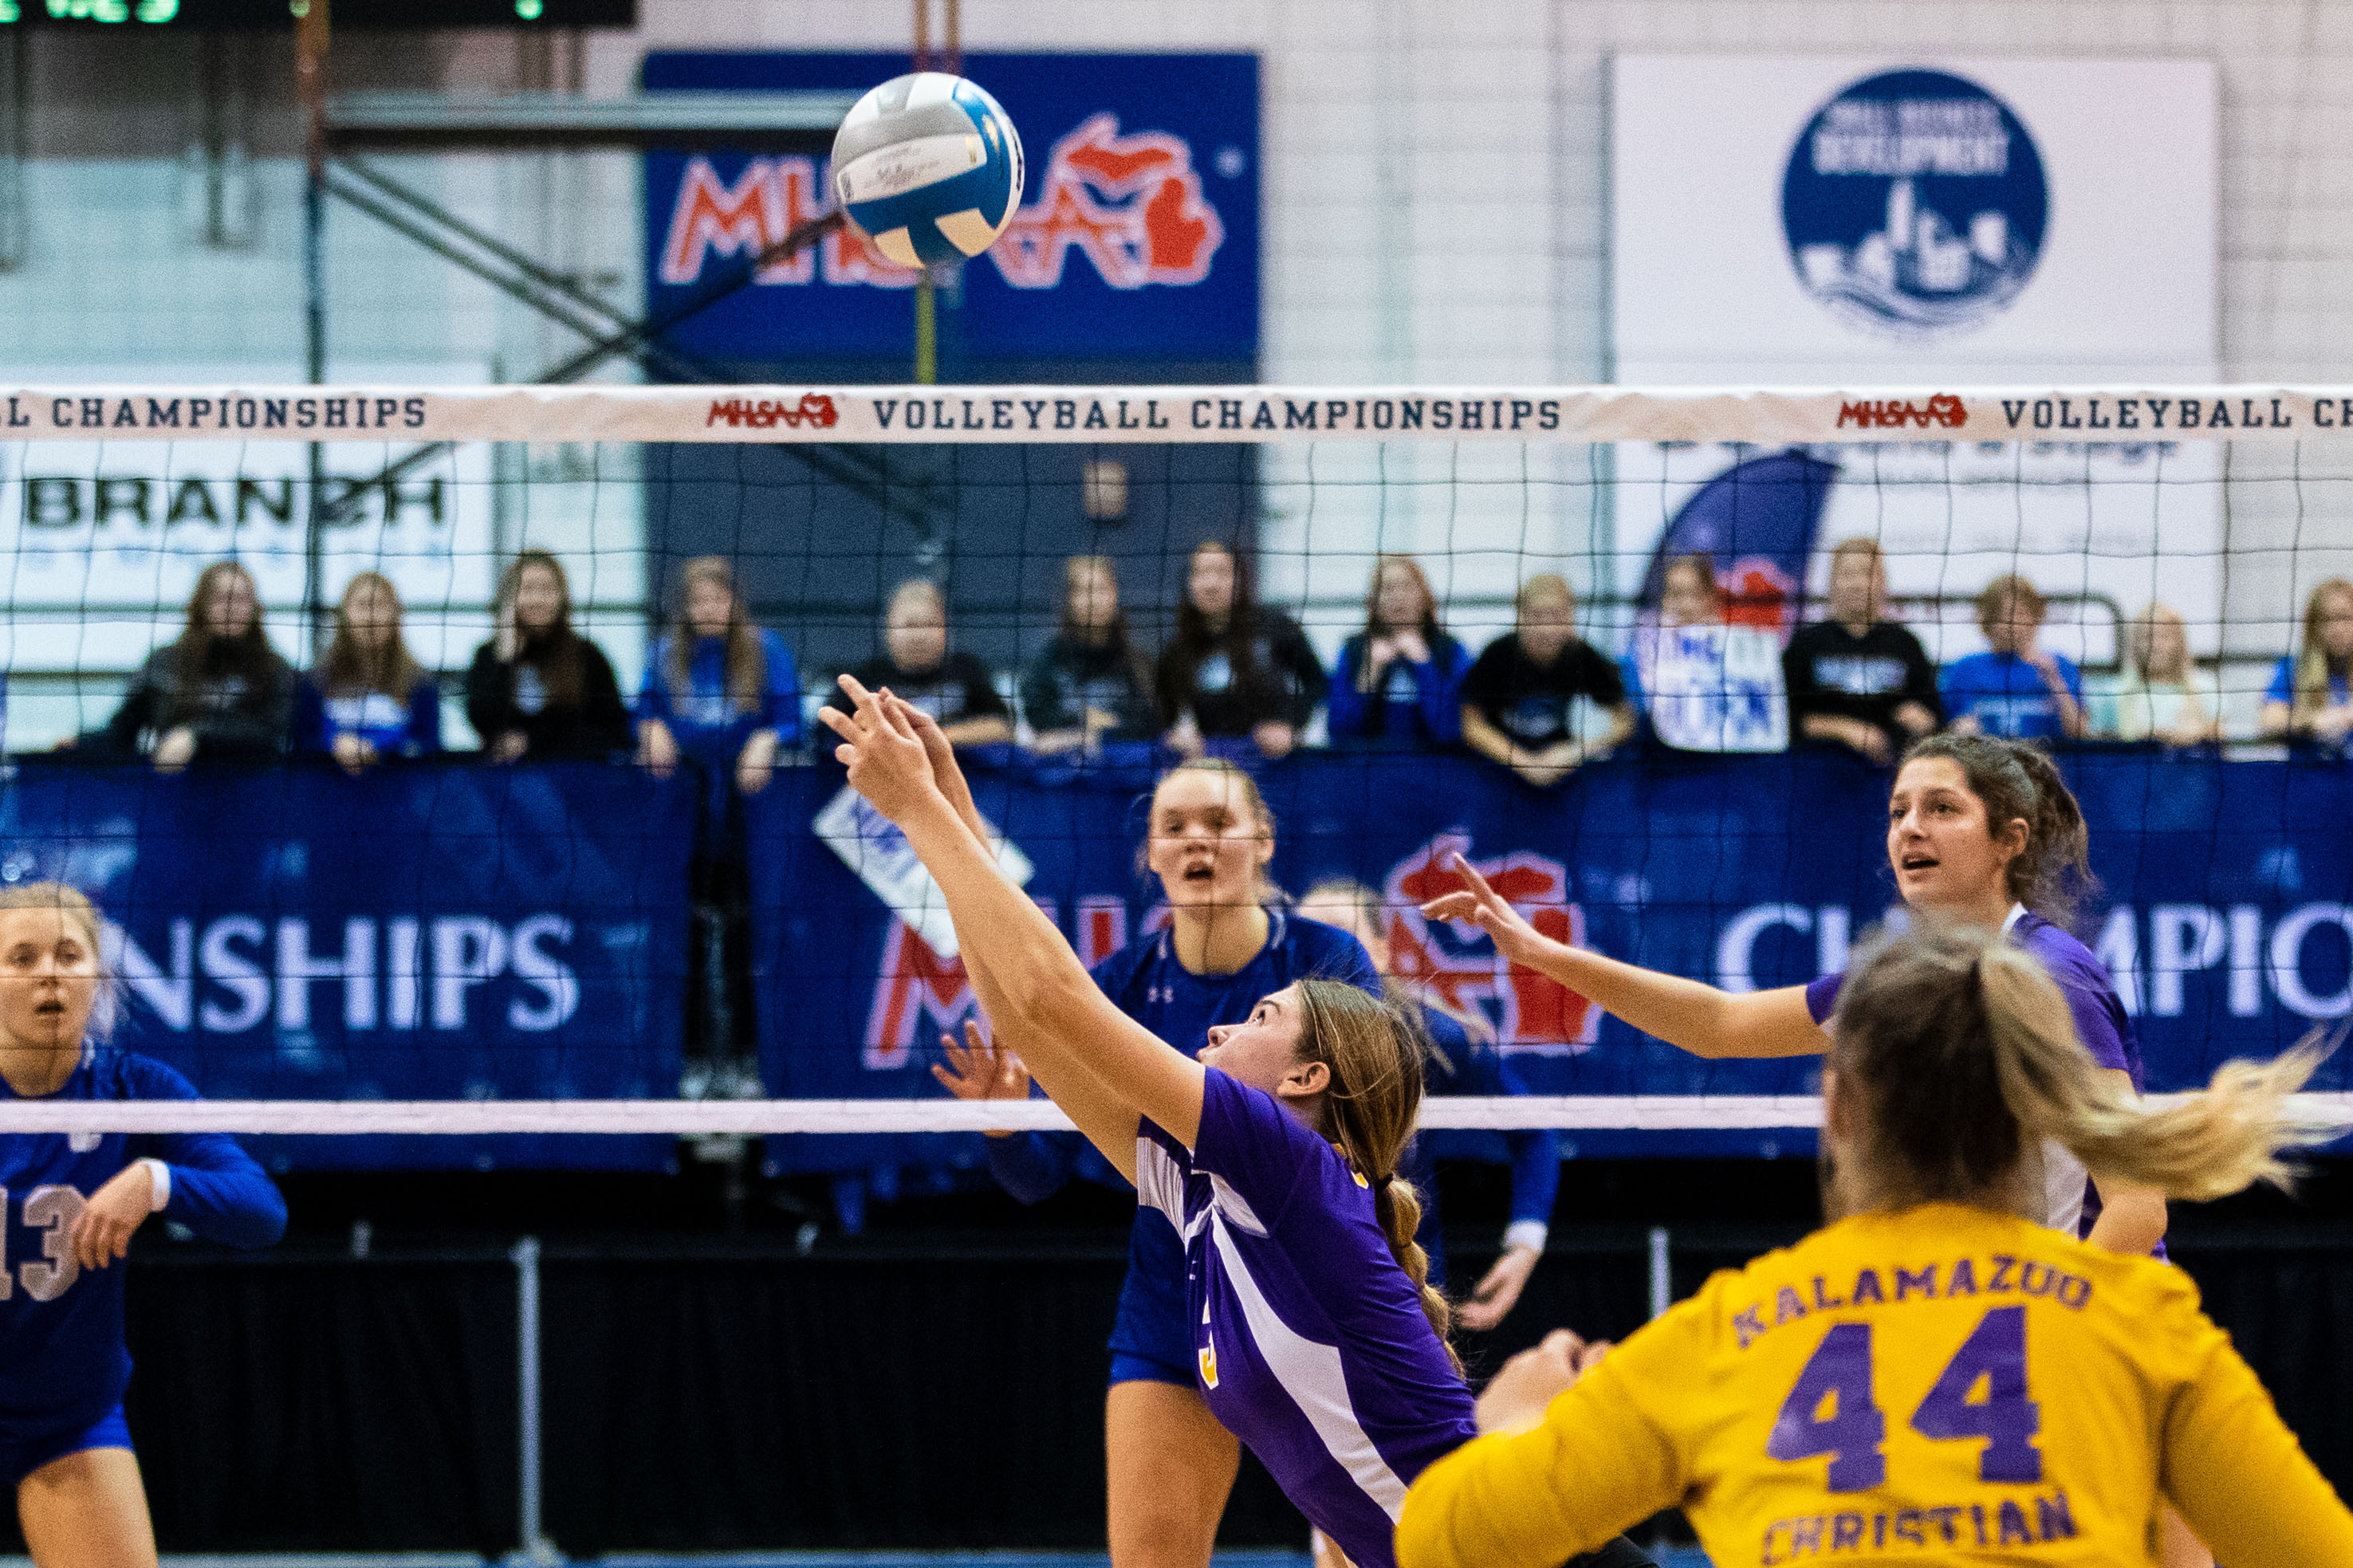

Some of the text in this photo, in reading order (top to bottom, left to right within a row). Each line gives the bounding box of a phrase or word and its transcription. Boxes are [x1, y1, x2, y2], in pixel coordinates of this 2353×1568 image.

[51, 398, 426, 428] CHAMPIONSHIPS
[873, 399, 1561, 430] VOLLEYBALL CHAMPIONSHIPS
[2001, 399, 2292, 428] VOLLEYBALL
[1765, 1304, 2043, 1494] 44
